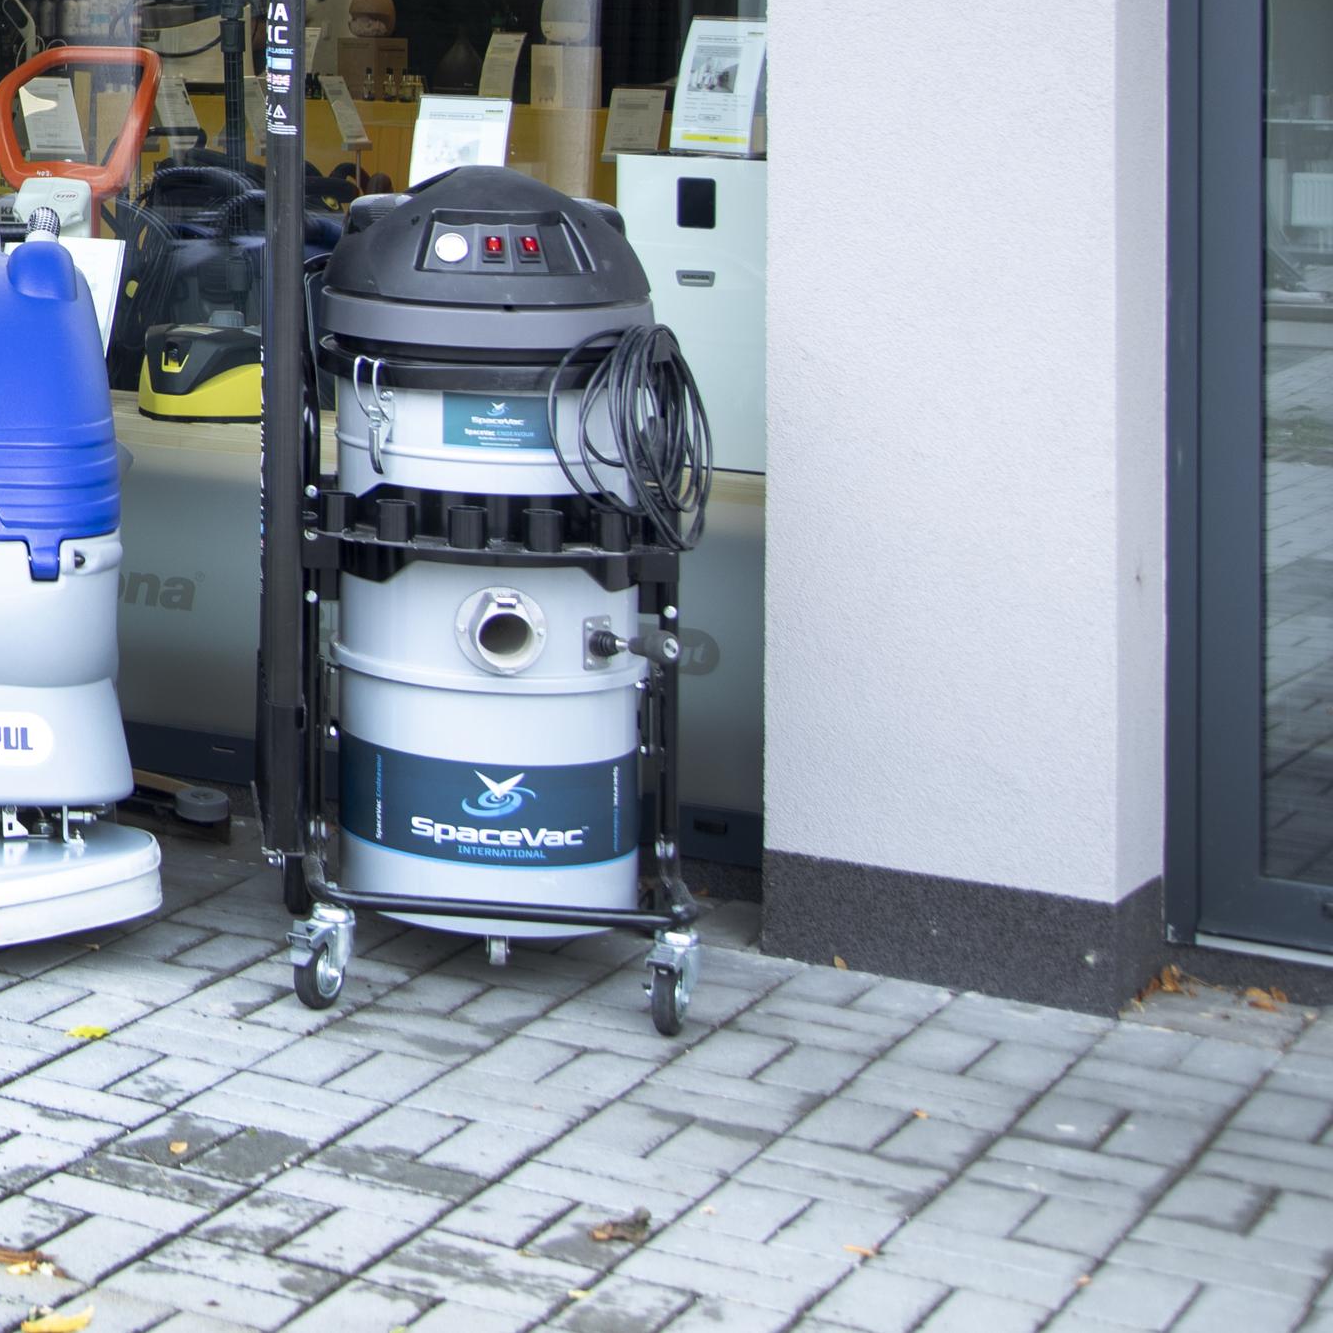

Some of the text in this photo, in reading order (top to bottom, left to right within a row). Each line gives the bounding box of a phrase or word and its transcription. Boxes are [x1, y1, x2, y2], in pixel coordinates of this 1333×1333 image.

[470, 415, 525, 426] SpaceVac
[409, 815, 584, 848] SpaceVac
[457, 844, 547, 860] INTERNATIONAL
